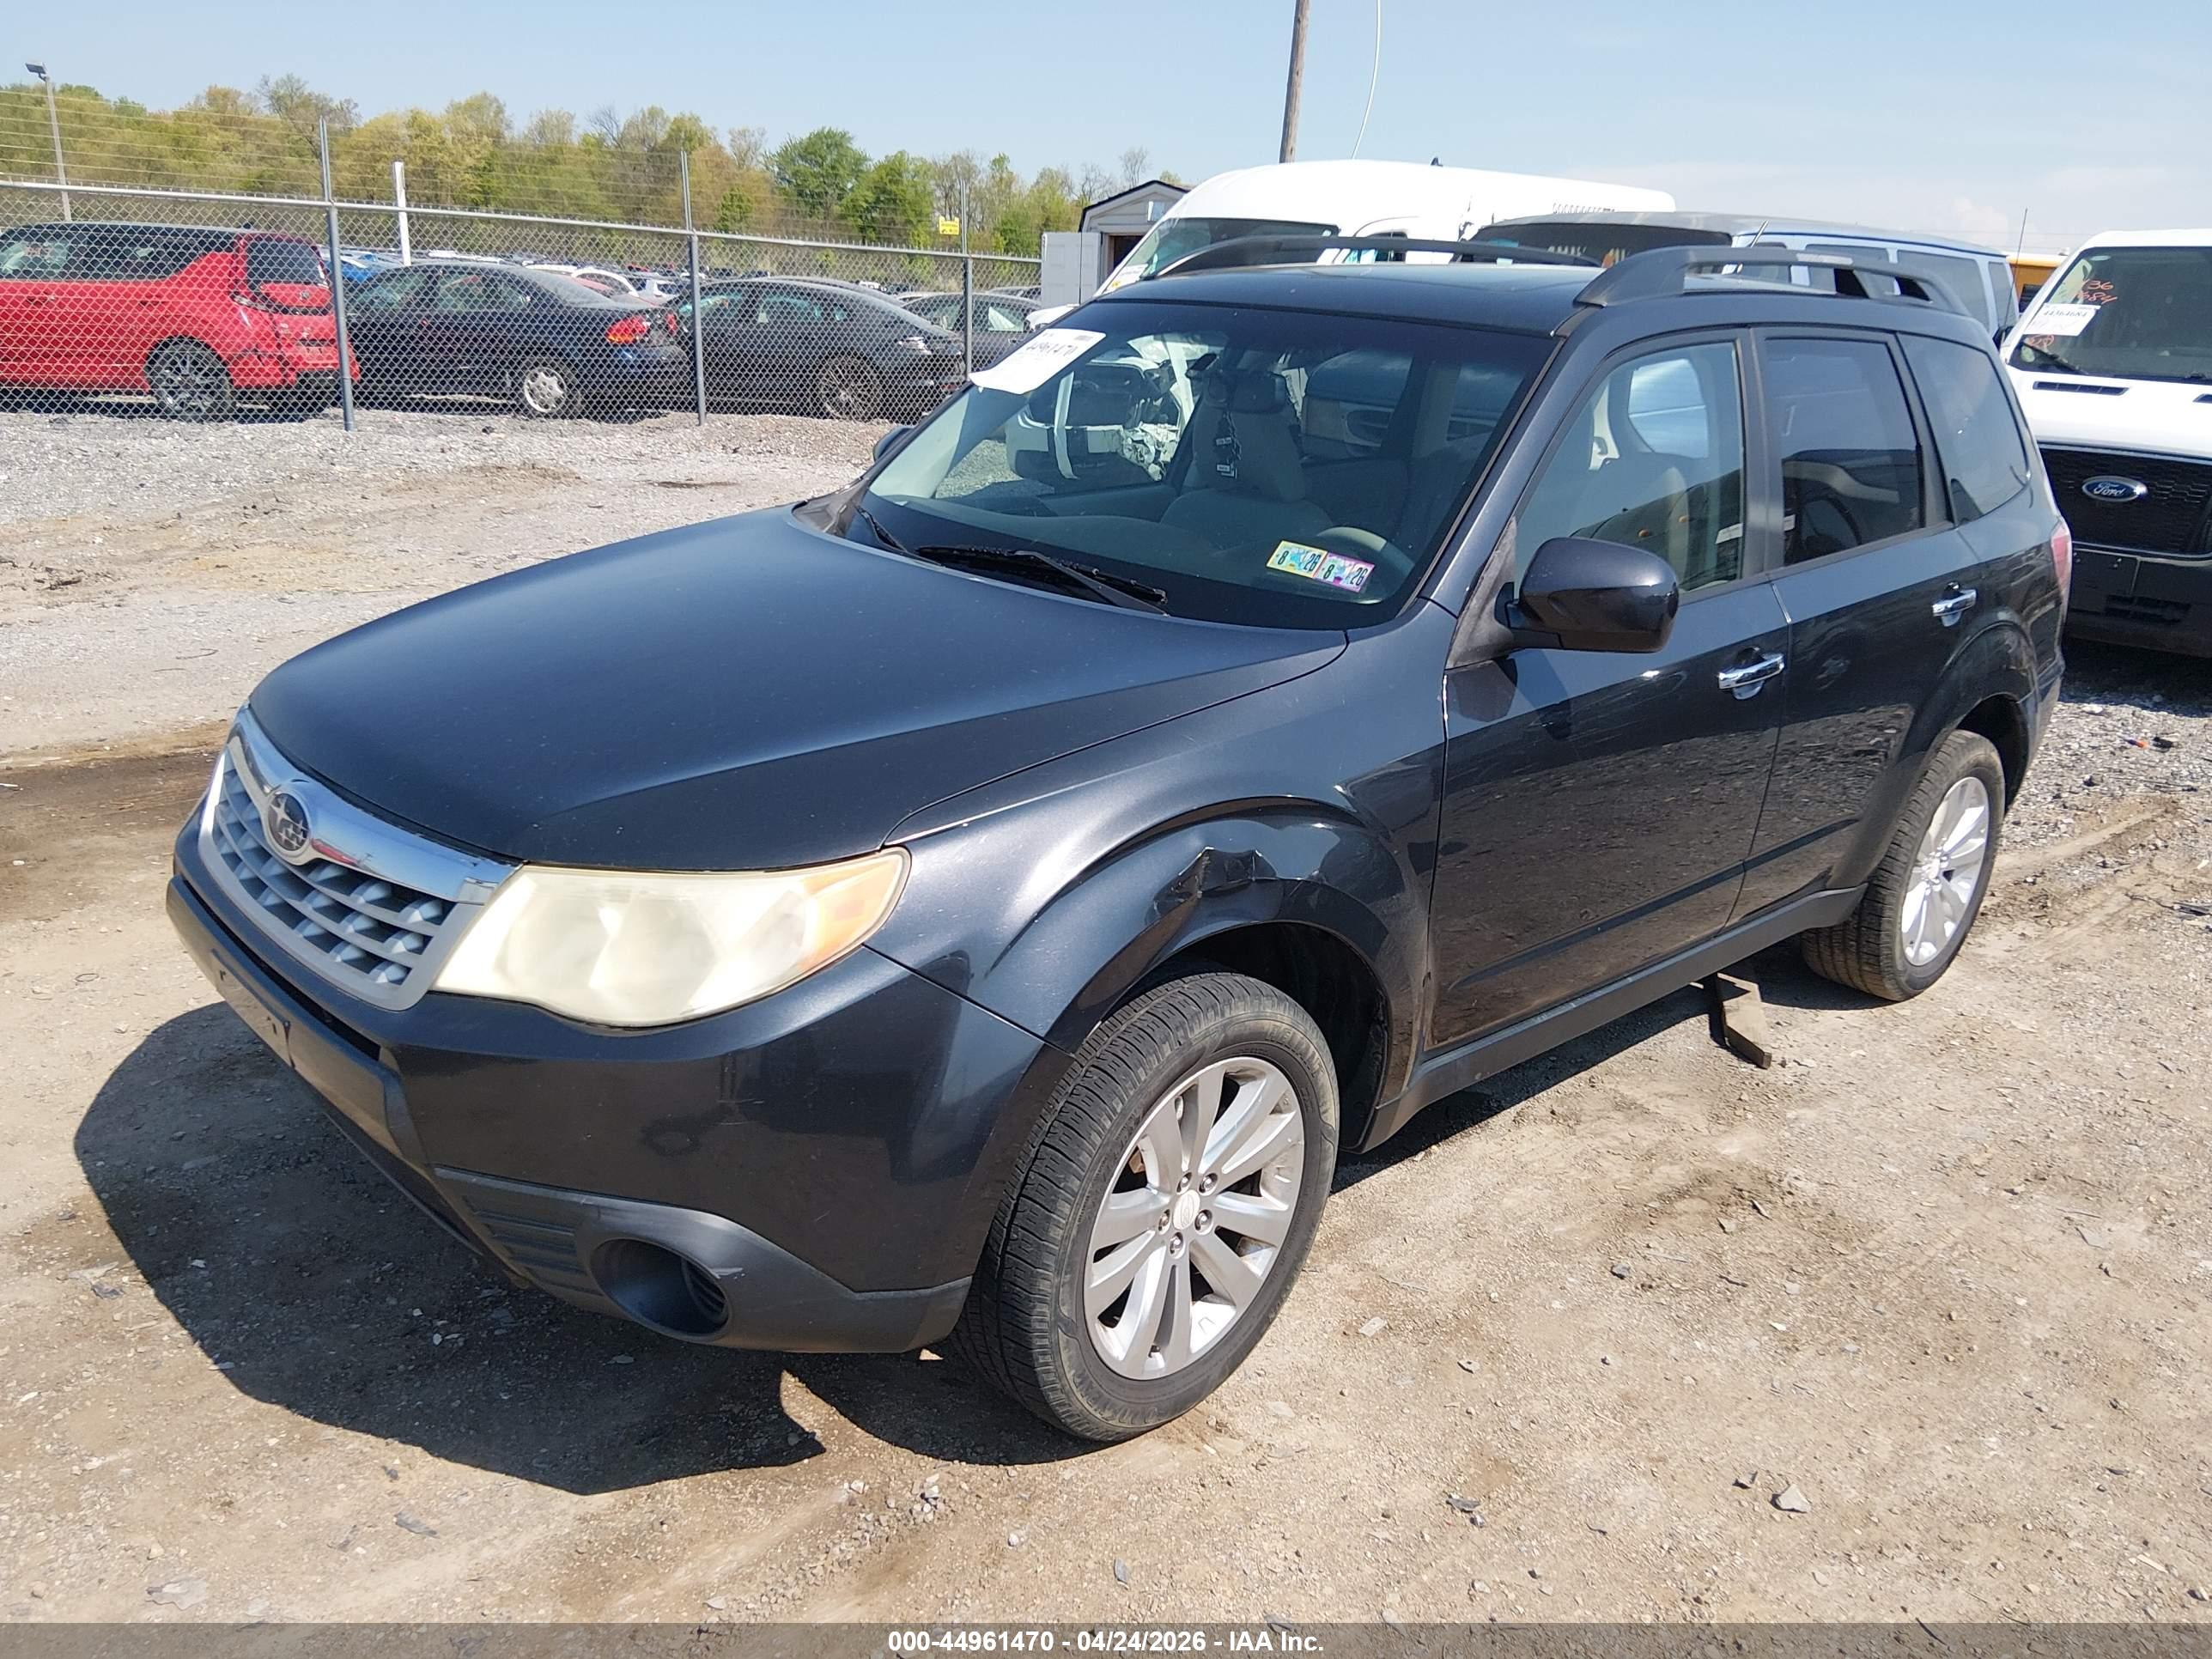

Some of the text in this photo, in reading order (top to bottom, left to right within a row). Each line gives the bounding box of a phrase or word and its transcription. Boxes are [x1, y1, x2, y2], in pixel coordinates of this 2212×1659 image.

[2093, 482, 2126, 495] Ford
[1278, 550, 1290, 565] 8
[1323, 564, 1369, 586] 8 26
